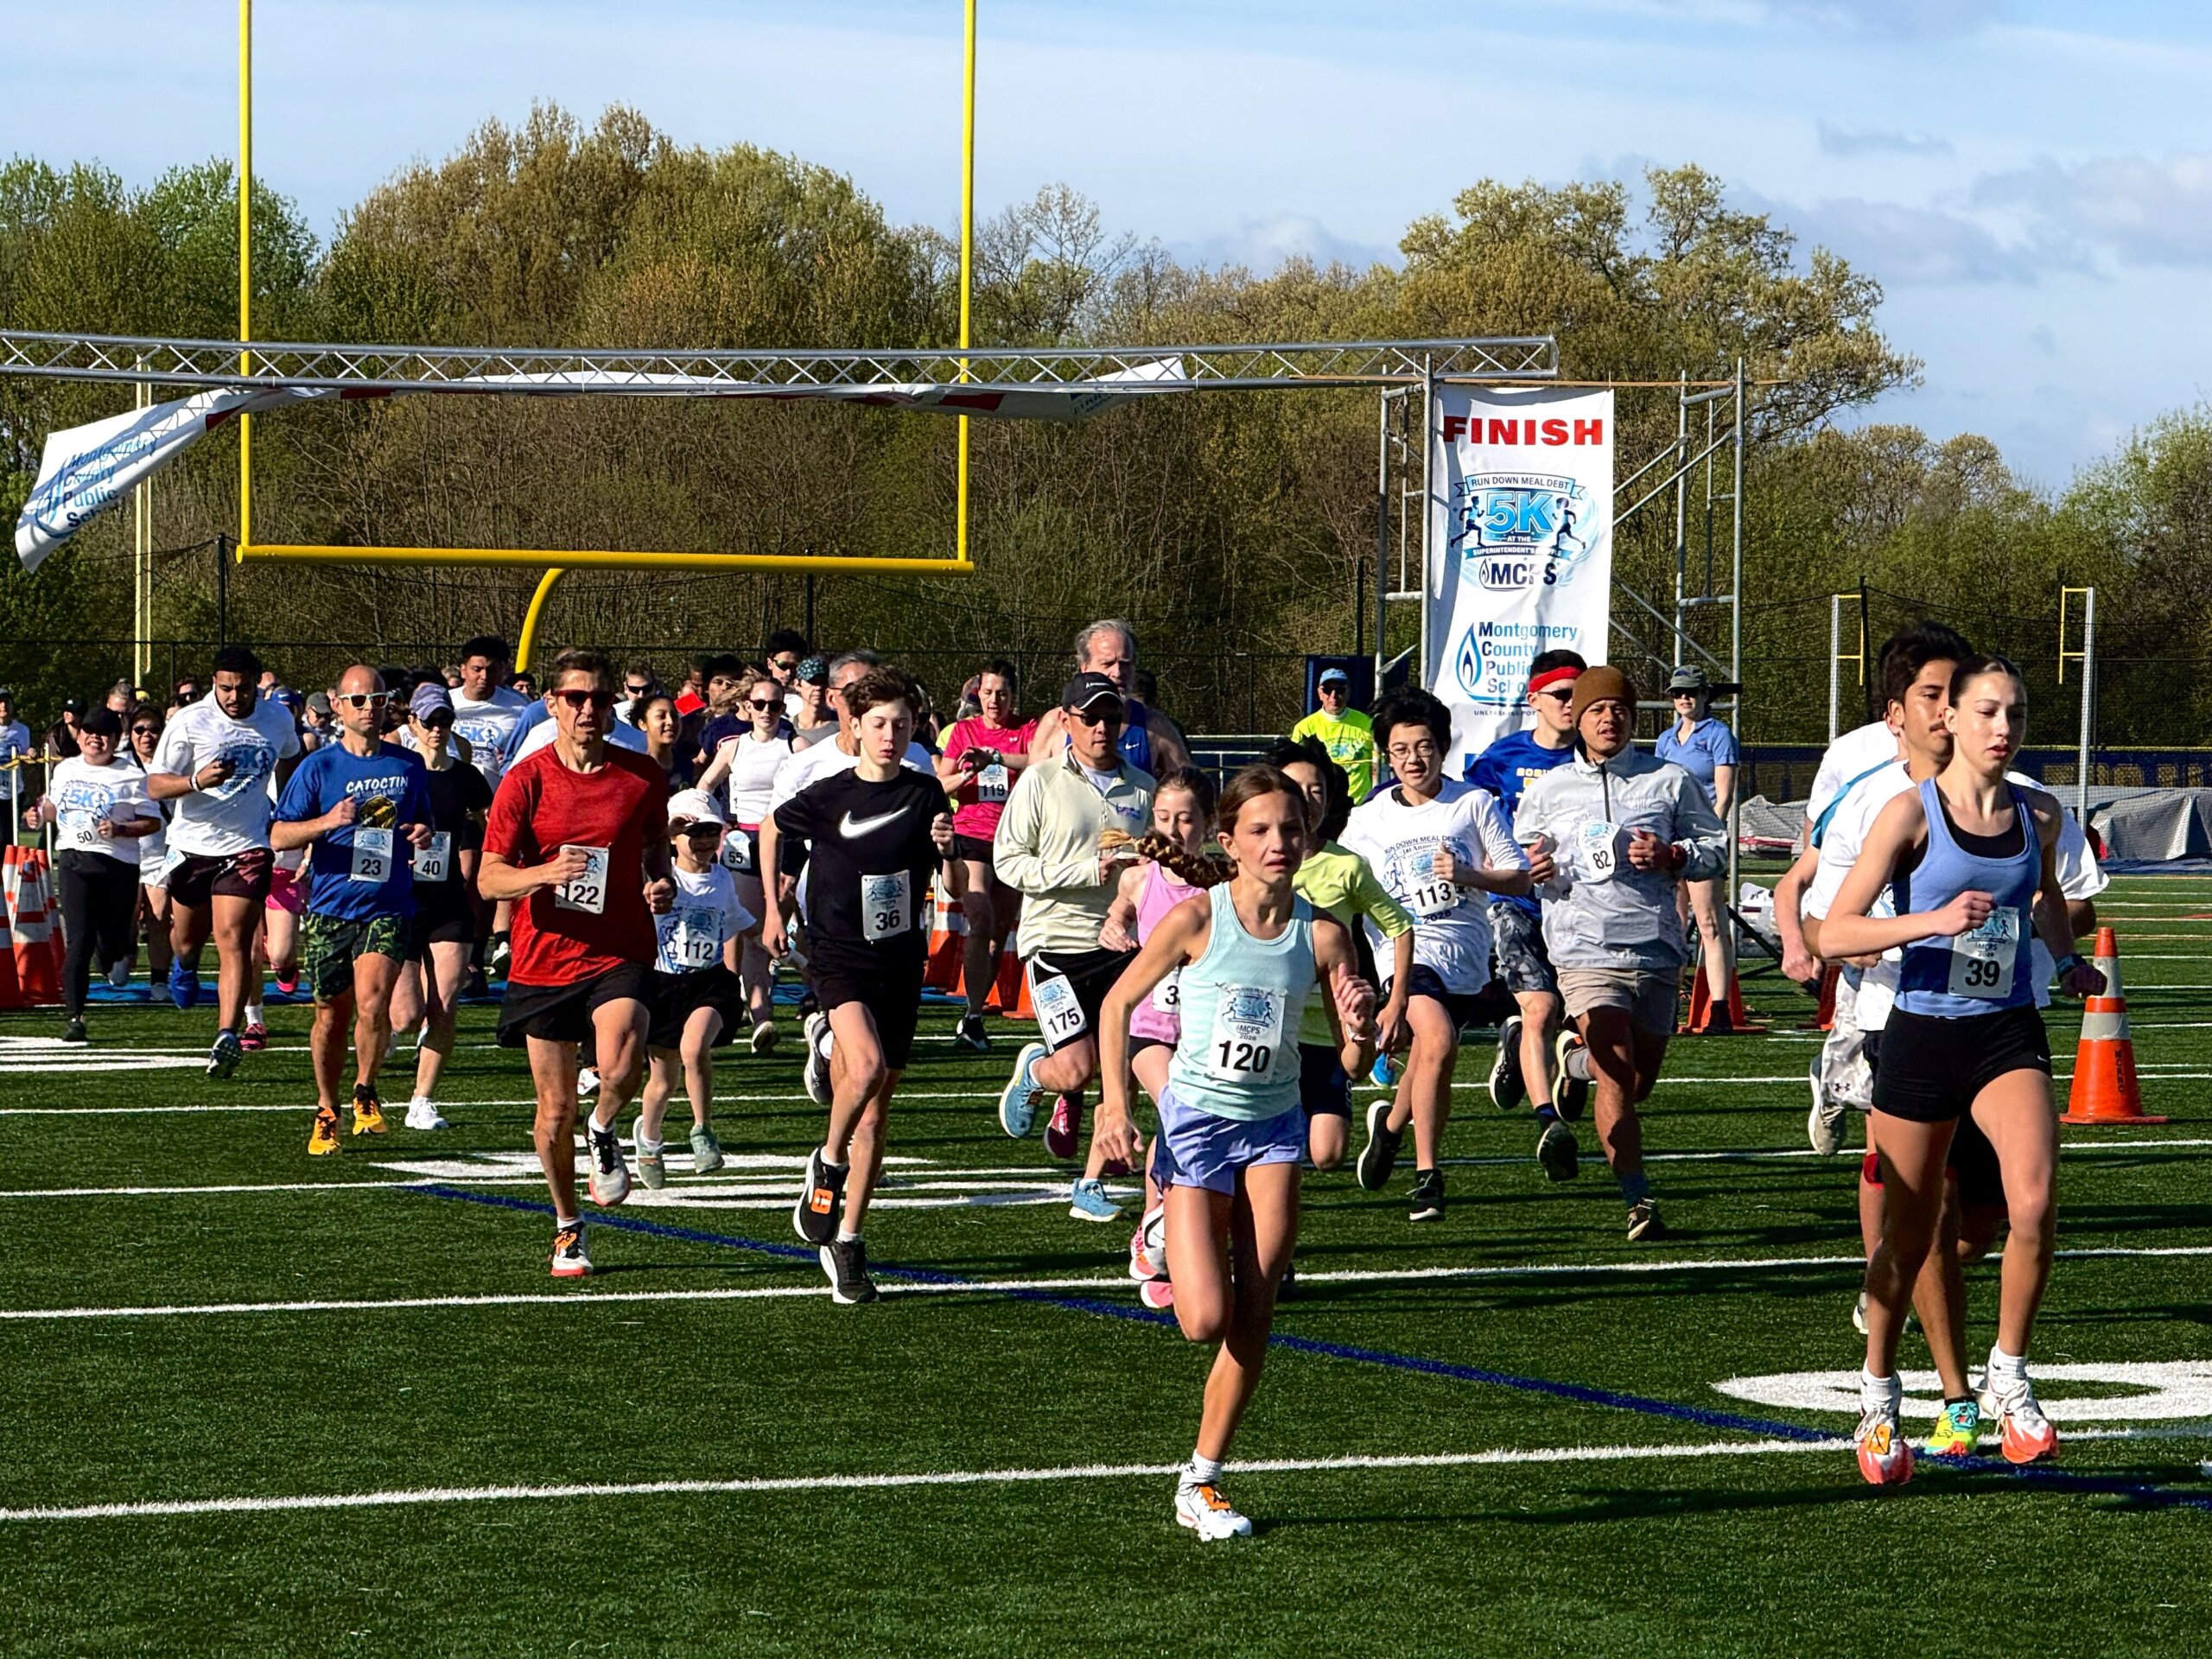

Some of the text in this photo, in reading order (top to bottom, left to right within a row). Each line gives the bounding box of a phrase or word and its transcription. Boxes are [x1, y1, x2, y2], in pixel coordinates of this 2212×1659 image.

[1443, 416, 1604, 446] FINISH
[1471, 476, 1570, 490] RUN DOWN MEAL DEBT
[62, 486, 118, 509] Public
[1484, 491, 1554, 534] 5K
[1478, 621, 1578, 641] Montgomery
[1481, 641, 1538, 658] County
[1485, 660, 1531, 676] Public
[459, 726, 486, 743] 5K
[346, 776, 409, 793] CATOCTIN
[982, 784, 1005, 797] 119
[68, 788, 95, 808] 5K
[76, 830, 92, 844] 50
[1395, 837, 1419, 850] DOWN
[1420, 835, 1440, 843] MEAL
[728, 850, 744, 864] 55
[1592, 850, 1612, 870] 82
[360, 859, 382, 876] 23
[422, 860, 441, 875] 40
[562, 882, 600, 906] 122
[1414, 882, 1452, 907] 113
[875, 909, 900, 931] 36
[683, 939, 714, 960] 112
[1965, 959, 2000, 987] 39
[1165, 976, 1180, 1005] 3
[1047, 1007, 1081, 1035] 175
[1240, 1024, 1261, 1034] MCPS
[1218, 1040, 1271, 1073] 120
